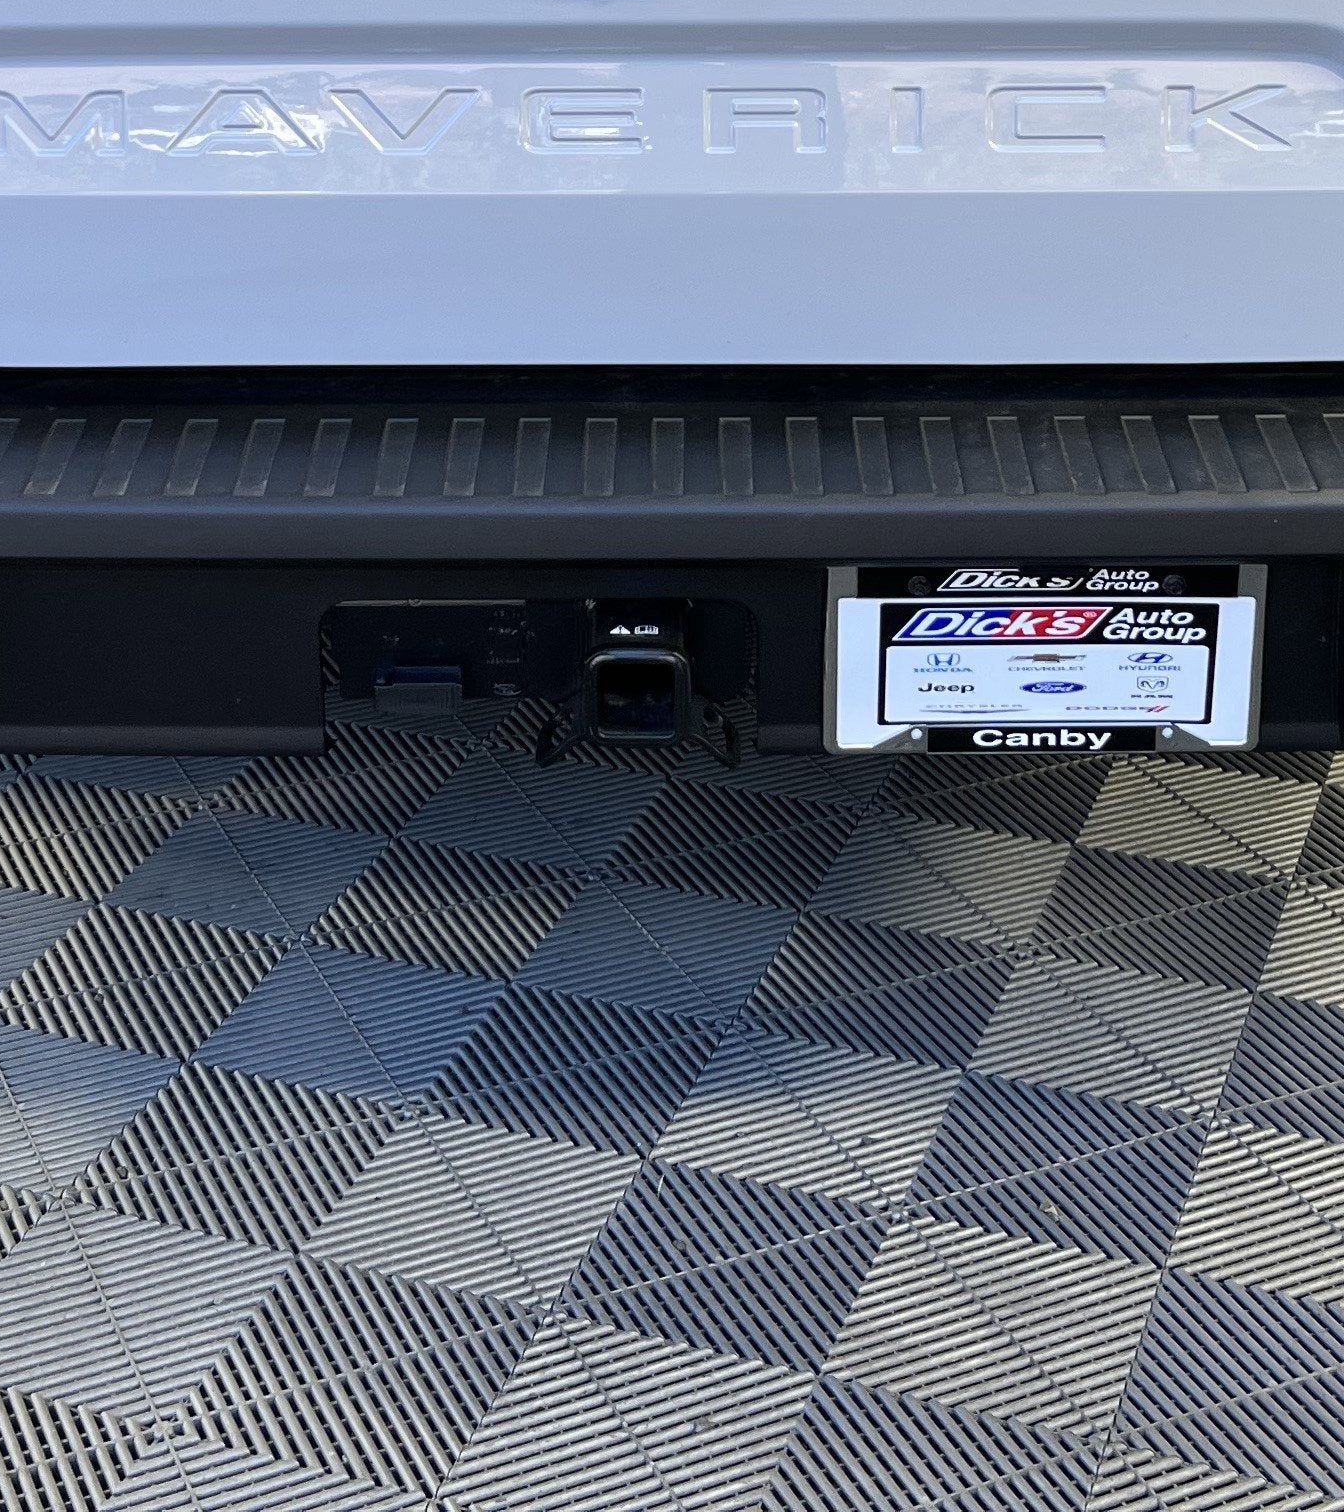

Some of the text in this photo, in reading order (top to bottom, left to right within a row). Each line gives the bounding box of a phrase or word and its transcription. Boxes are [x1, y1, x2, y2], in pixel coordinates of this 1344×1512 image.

[1092, 568, 1150, 581] Auto
[1085, 578, 1160, 593] Group
[909, 609, 1085, 637] Dick's
[1108, 607, 1195, 625] Auto
[1102, 622, 1207, 644] Group
[917, 682, 976, 694] Jeep
[972, 728, 1112, 750] Canby
